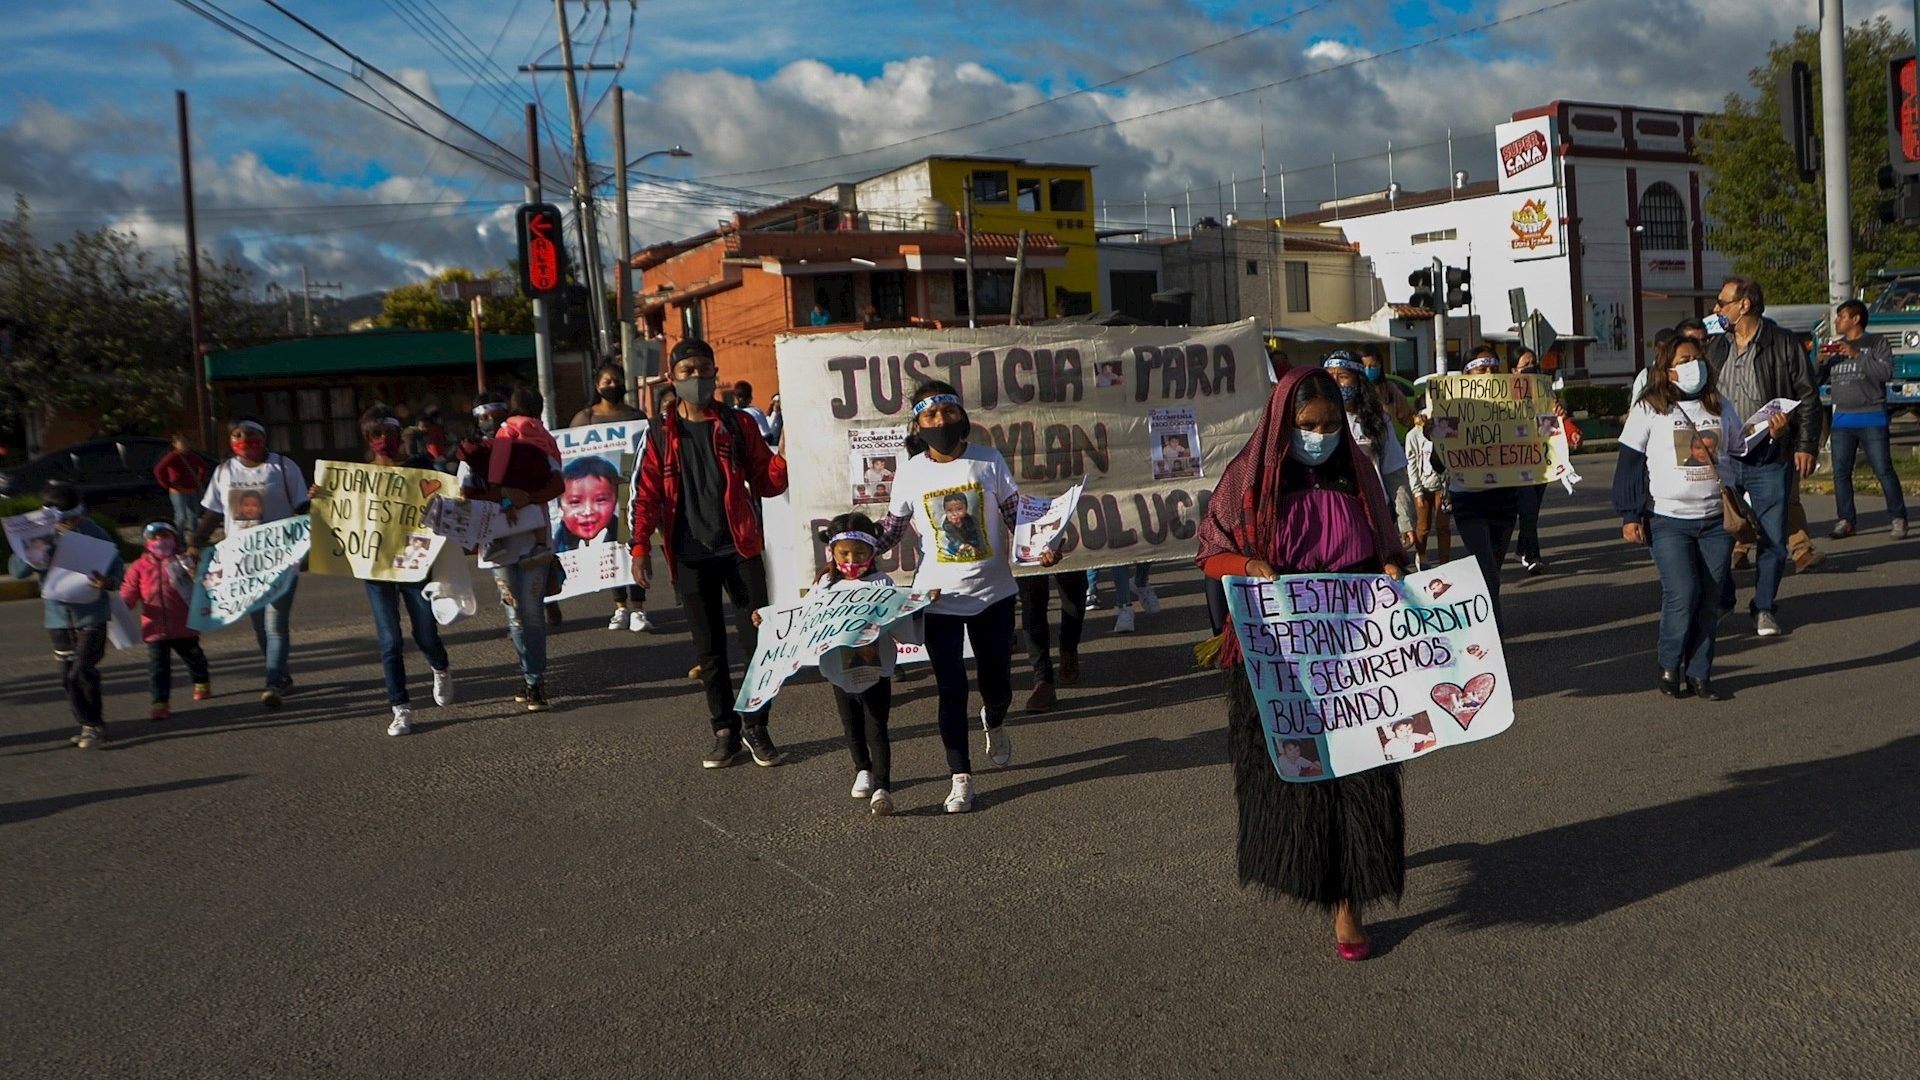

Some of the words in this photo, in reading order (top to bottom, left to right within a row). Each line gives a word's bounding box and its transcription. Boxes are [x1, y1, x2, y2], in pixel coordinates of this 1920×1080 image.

[1502, 132, 1541, 161] SUPER
[1506, 146, 1542, 171] CAVA
[536, 240, 550, 288] ALTO
[827, 347, 1083, 420] JUSTICIA
[1133, 344, 1236, 402] PARA
[1429, 378, 1454, 401] HAN
[1460, 378, 1508, 399] PASADO
[1513, 378, 1532, 400] 42
[1152, 413, 1192, 421] RECOMPENSA
[1440, 402, 1451, 418] Y
[1458, 401, 1475, 423] NO
[1482, 400, 1535, 422] SABEMOS
[556, 426, 626, 449] LAN
[853, 435, 904, 443] RECOMPENSA
[1466, 424, 1502, 446] NADA
[326, 467, 406, 497] JUANITA
[330, 499, 351, 520] NO
[367, 499, 427, 529] ESTAS
[331, 527, 383, 562] SOLA
[1233, 581, 1280, 618] TE
[1286, 577, 1399, 615] ESTAMOS
[807, 618, 868, 648] HIJO
[1243, 618, 1383, 657] ESPERANDO
[1390, 594, 1489, 641] GORDITO
[897, 646, 919, 654] 400
[1249, 659, 1262, 690] Y
[1269, 662, 1303, 693] TE
[1310, 637, 1450, 696] SEGUIREMOS
